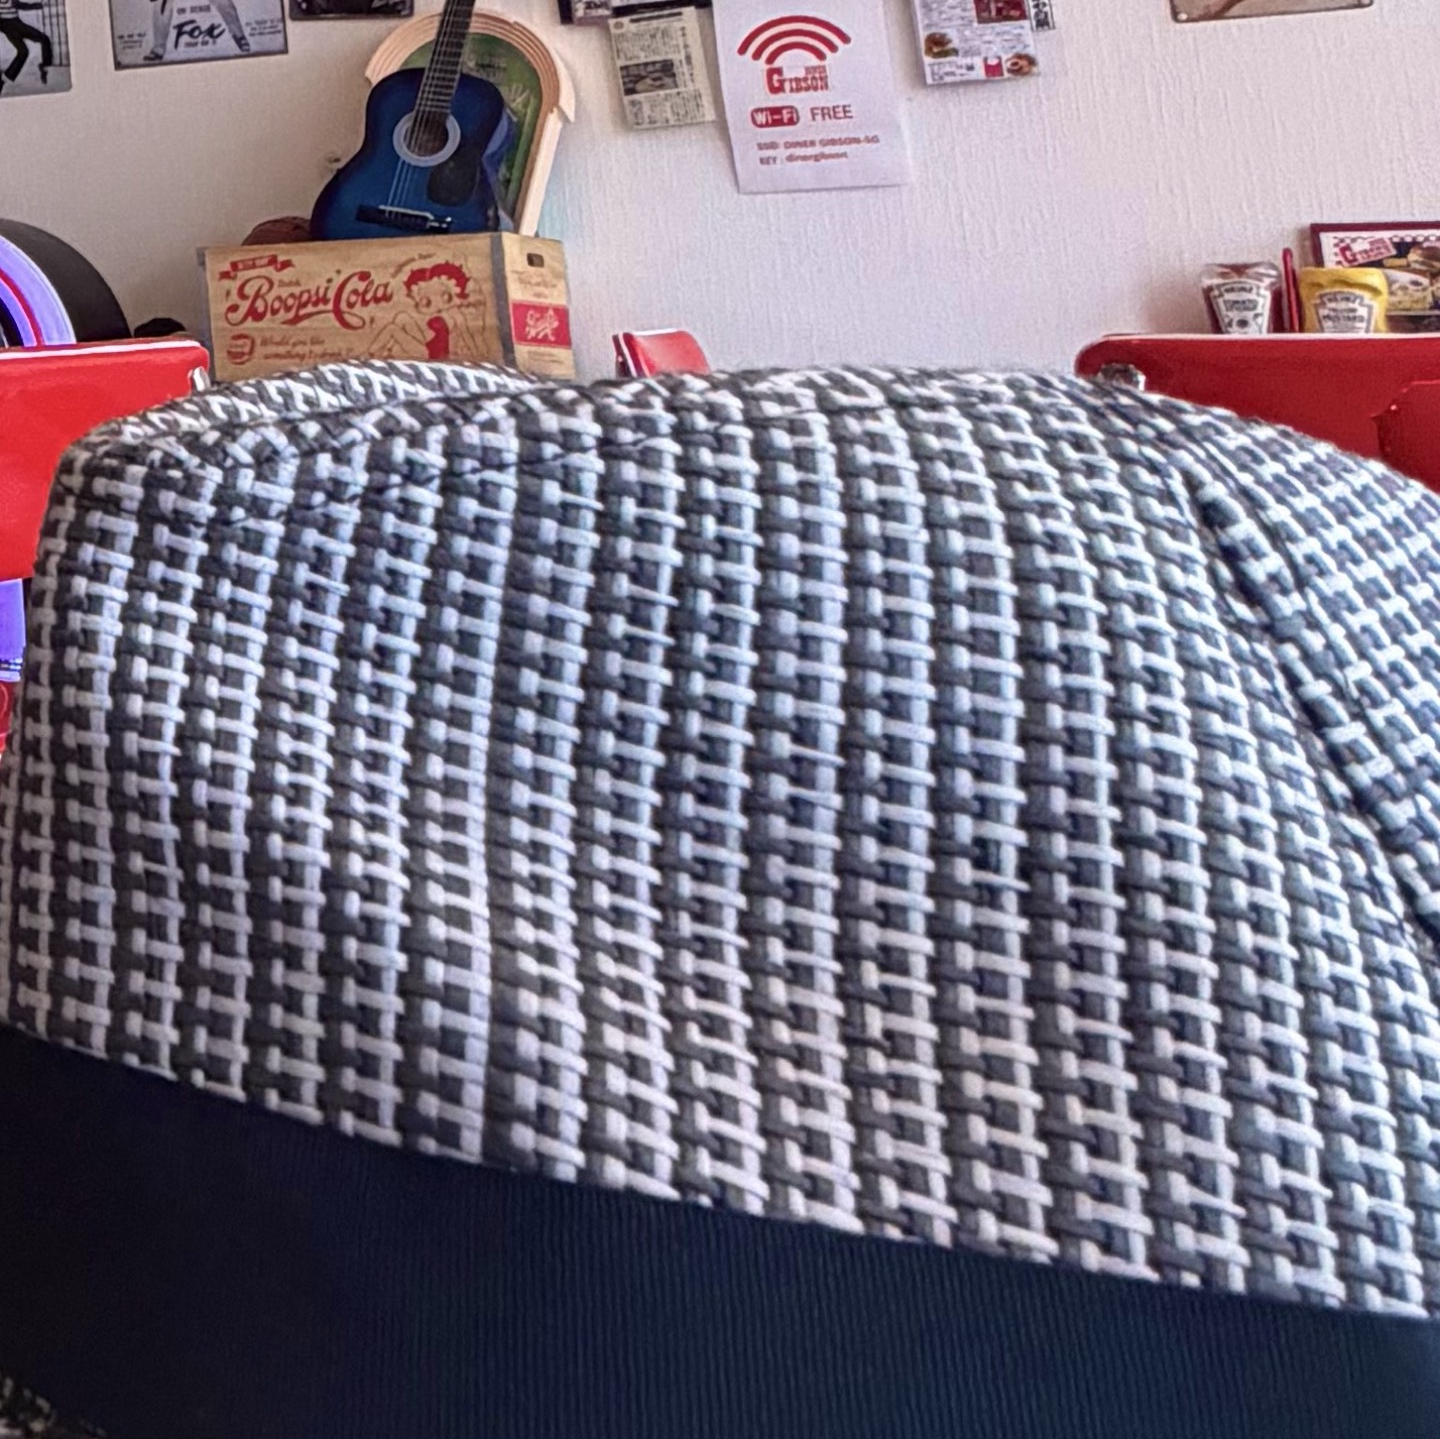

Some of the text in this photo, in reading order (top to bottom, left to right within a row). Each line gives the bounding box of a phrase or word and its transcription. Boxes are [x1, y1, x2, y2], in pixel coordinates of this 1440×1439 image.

[172, 19, 226, 51] Fox
[764, 65, 830, 96] GIBSON
[752, 104, 854, 127] Wi-Fi FREE
[224, 270, 394, 330] Boopsi Cola
[1222, 284, 1254, 294] HEINZ
